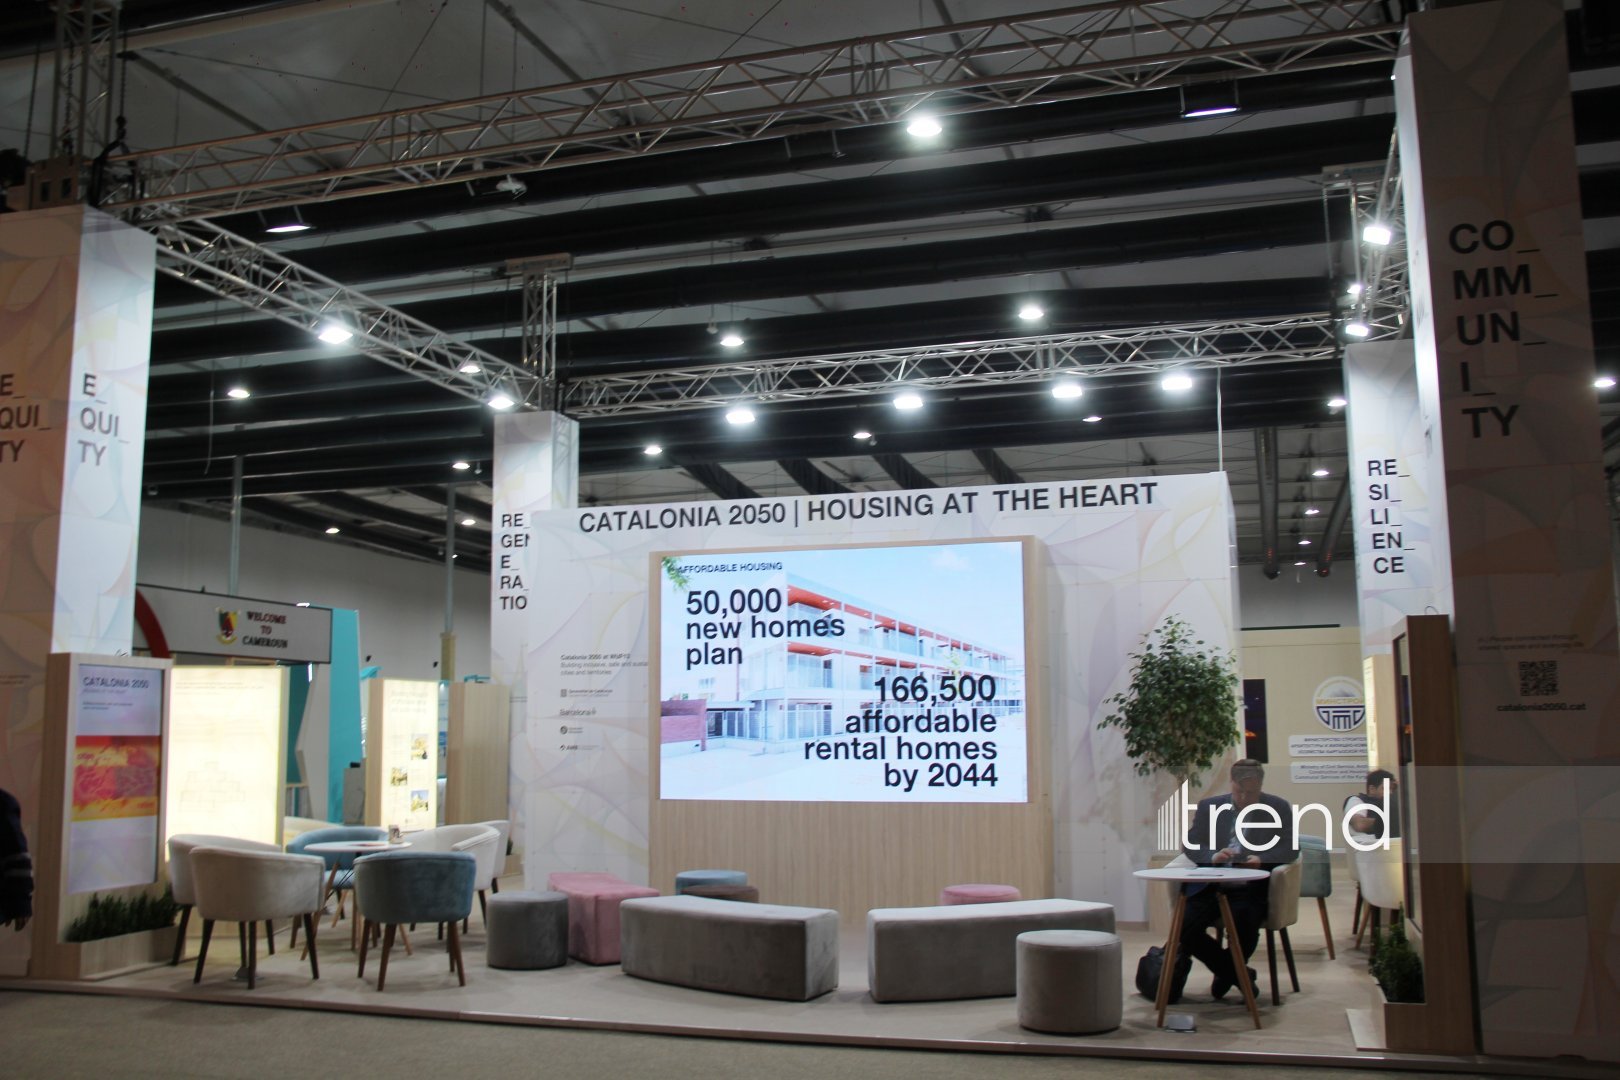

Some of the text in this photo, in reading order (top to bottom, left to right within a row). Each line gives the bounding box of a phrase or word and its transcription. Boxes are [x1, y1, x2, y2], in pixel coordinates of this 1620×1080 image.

[1461, 404, 1520, 438] TY
[78, 439, 107, 467] TY
[579, 505, 721, 533] CATALONIA
[728, 503, 787, 526] 2050
[807, 494, 935, 522] HOUSING
[943, 491, 979, 515] AT
[993, 488, 1050, 512] THE
[1059, 482, 1158, 509] HEART
[740, 561, 783, 572] HOUSING
[1373, 557, 1405, 574] CE
[686, 587, 783, 619] 50,000
[247, 611, 287, 625] WELCOME
[261, 625, 272, 635] TO
[686, 614, 846, 640] new homes
[686, 643, 744, 671] plan
[83, 676, 130, 689] CATALONIA
[874, 673, 997, 707] 166,500
[845, 708, 997, 734] affordable
[804, 735, 998, 760] rental homes
[884, 762, 999, 792] by 2044
